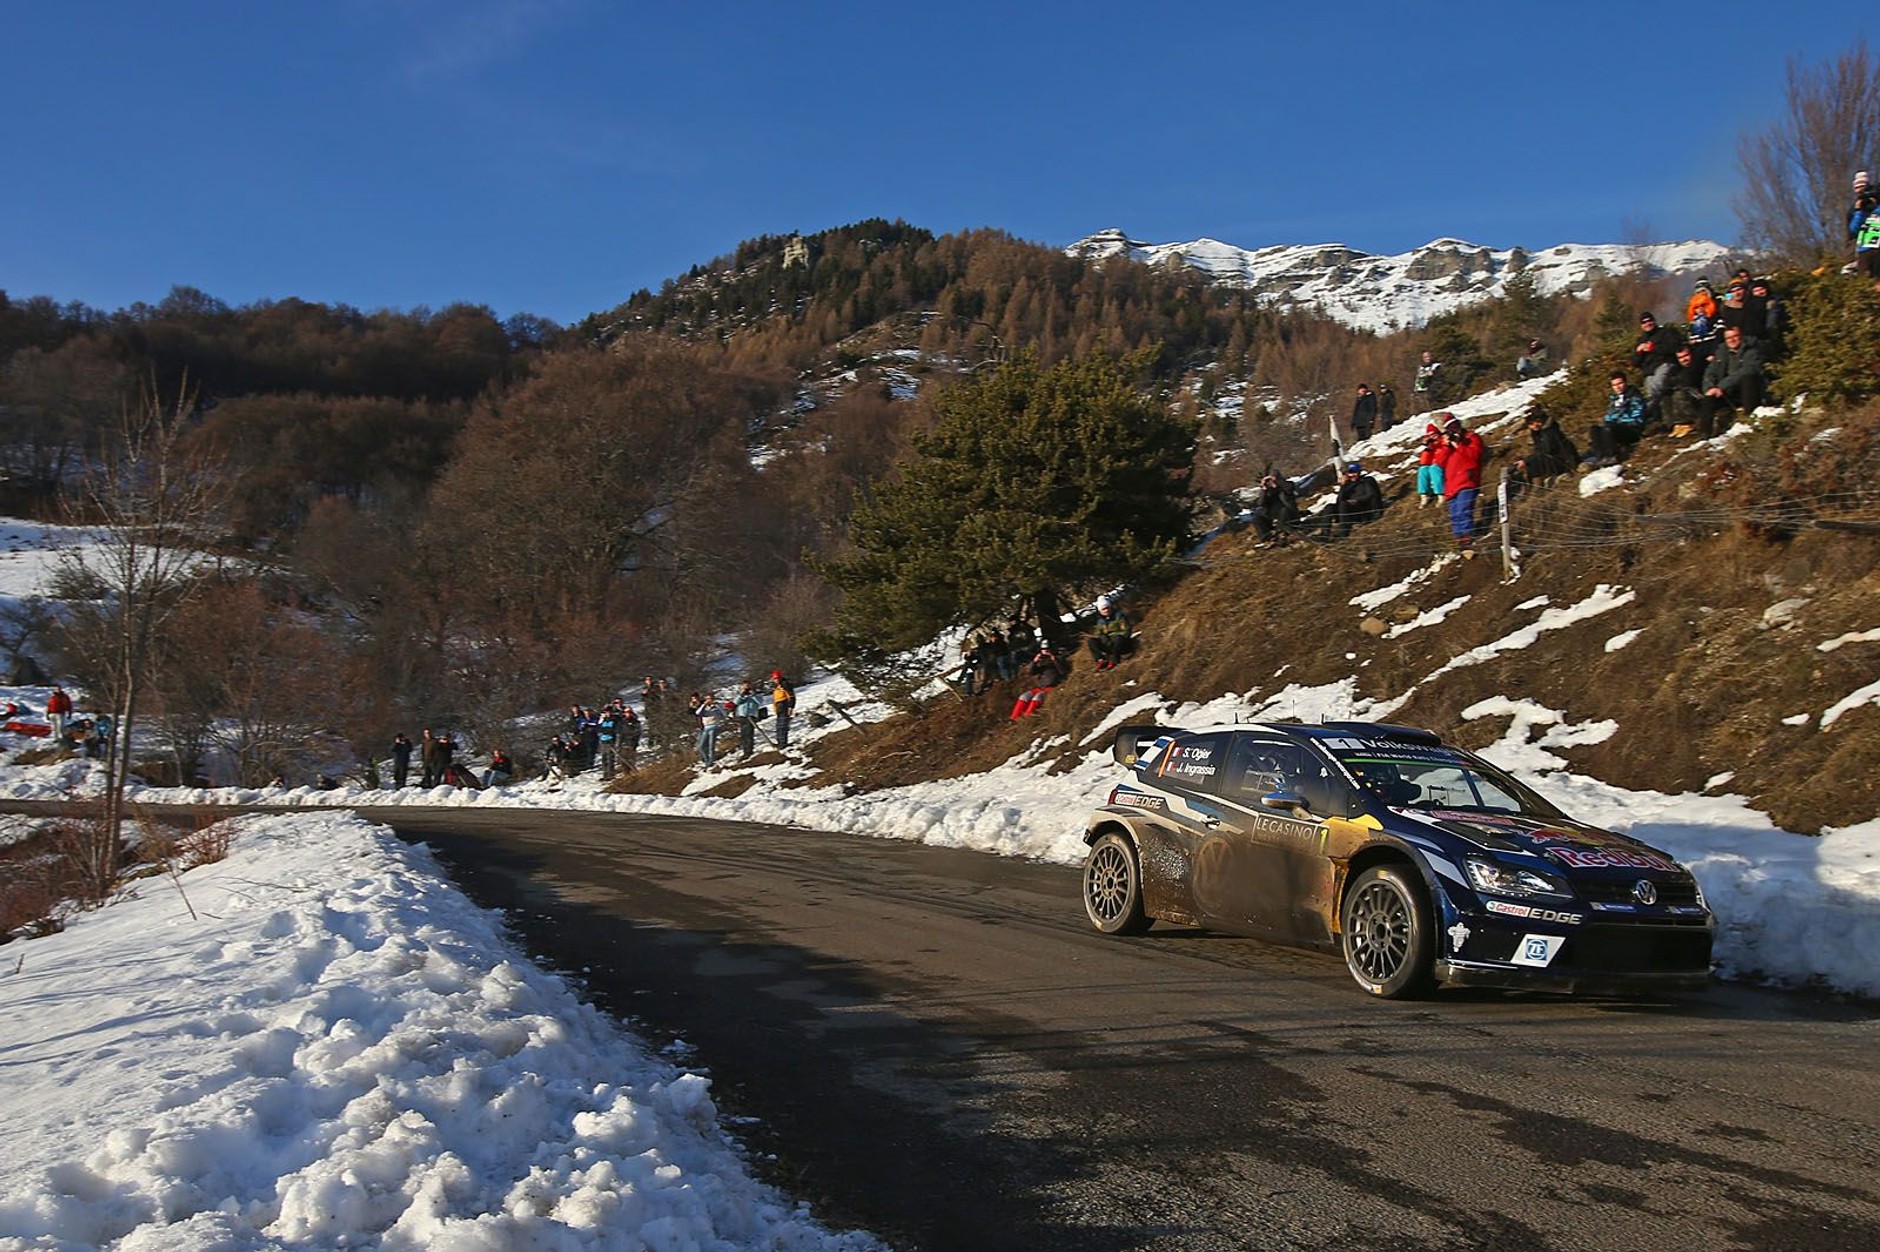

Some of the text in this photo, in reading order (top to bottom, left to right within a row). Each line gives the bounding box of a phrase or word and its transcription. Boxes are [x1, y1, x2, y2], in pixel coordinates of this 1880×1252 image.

[1191, 747, 1213, 761] Ogier
[1184, 762, 1216, 777] Ingrassia
[1134, 796, 1165, 810] EDGE
[1320, 828, 1329, 857] 1
[1495, 902, 1583, 925] Castrol EDGE
